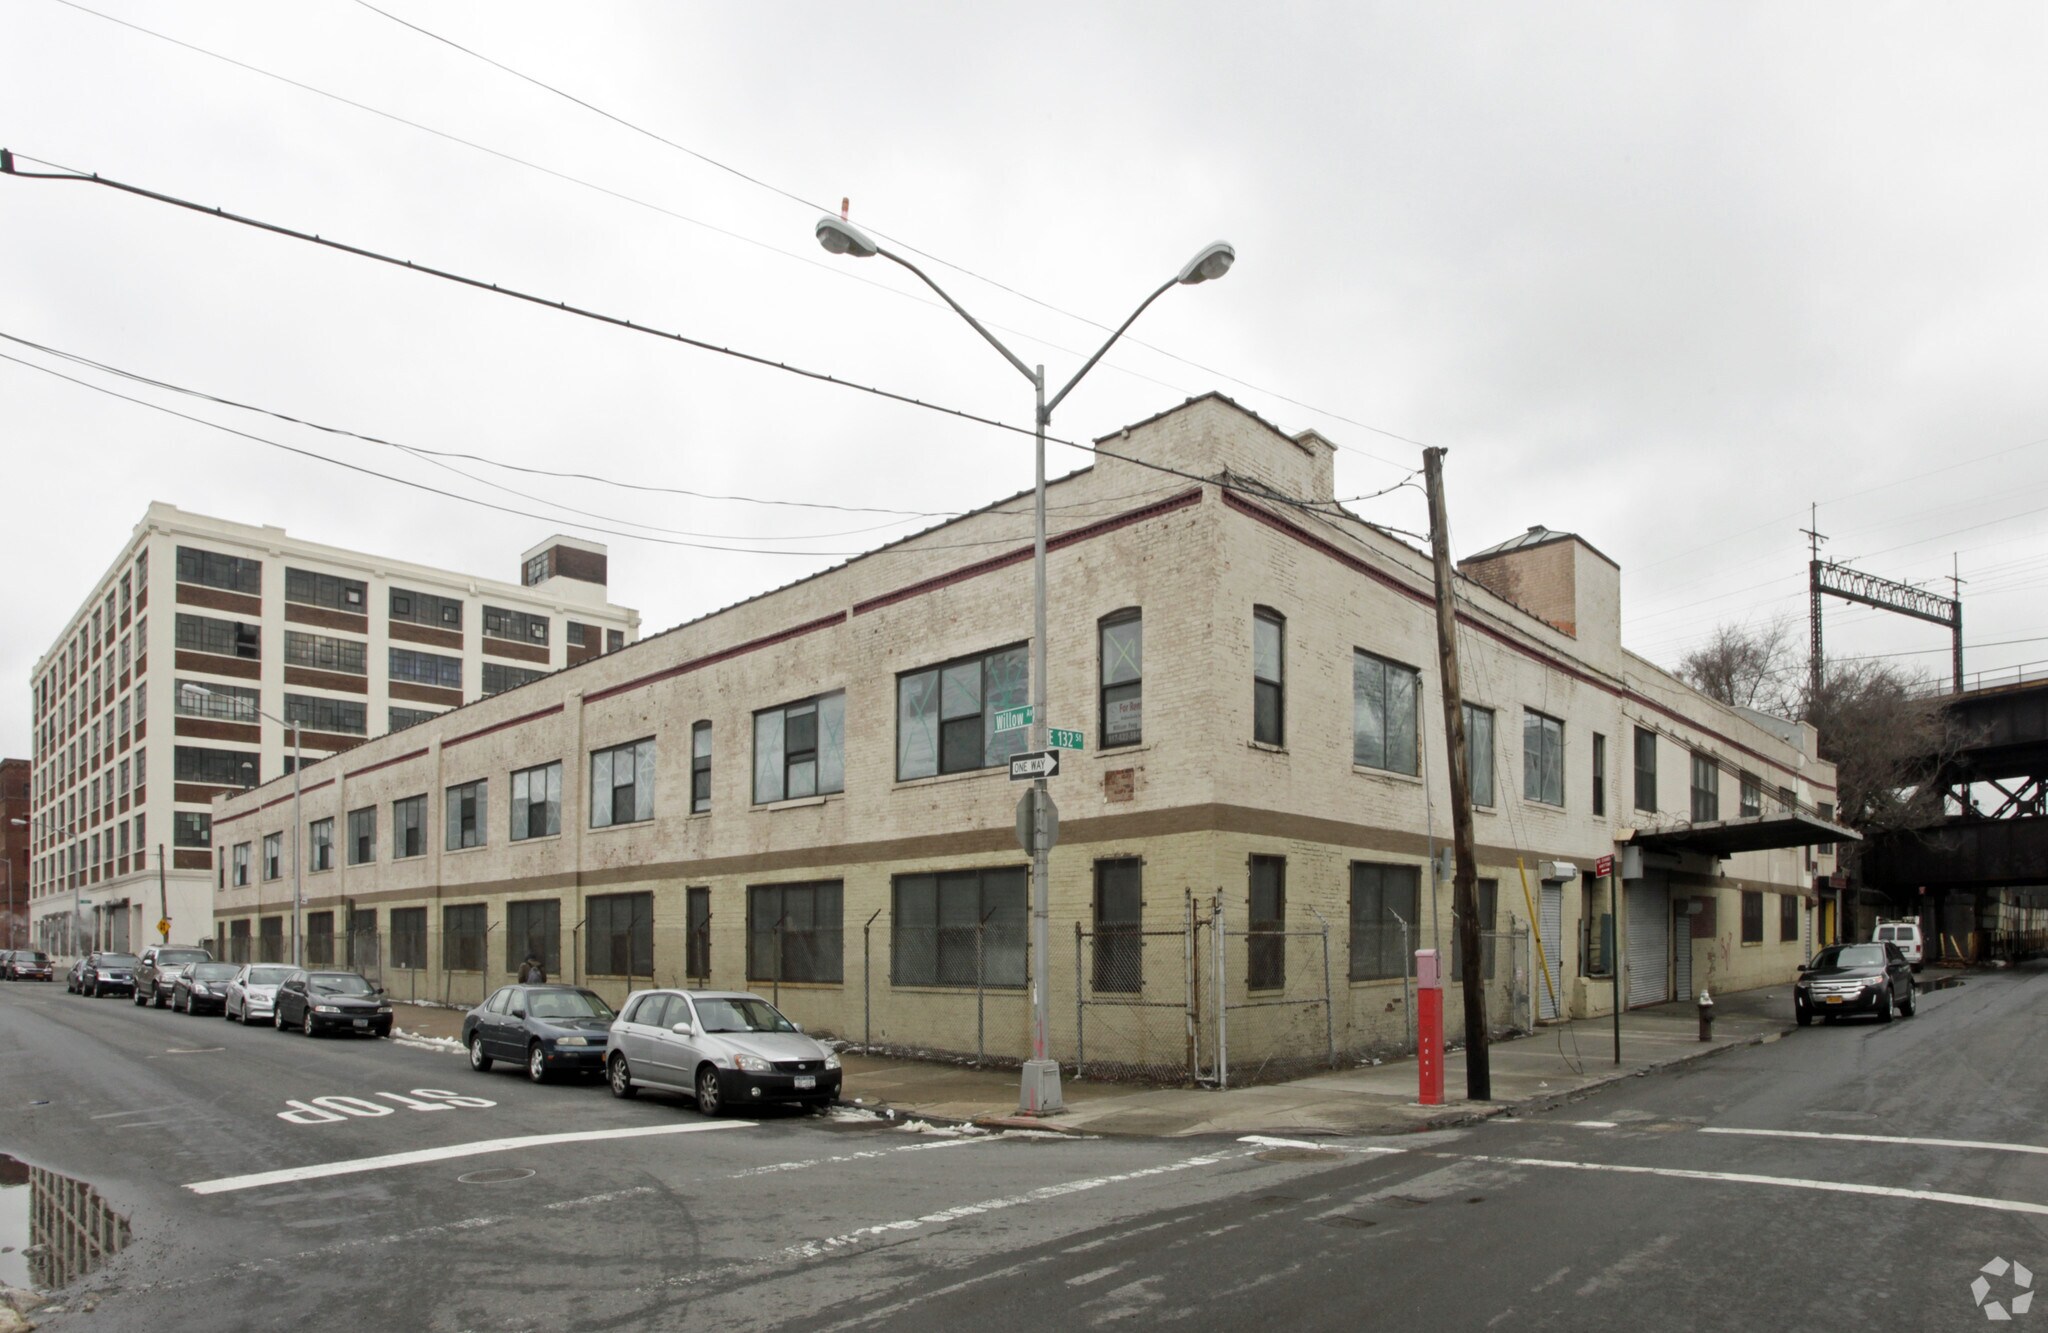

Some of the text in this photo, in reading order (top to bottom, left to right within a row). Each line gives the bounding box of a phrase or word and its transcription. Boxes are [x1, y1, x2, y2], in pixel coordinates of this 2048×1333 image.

[1129, 701, 1141, 711] Ren
[996, 711, 1024, 730] Willow
[1049, 730, 1054, 746] E
[1057, 731, 1074, 748] 132
[1014, 759, 1046, 773] ONE WAY
[276, 1088, 498, 1124] STOP
